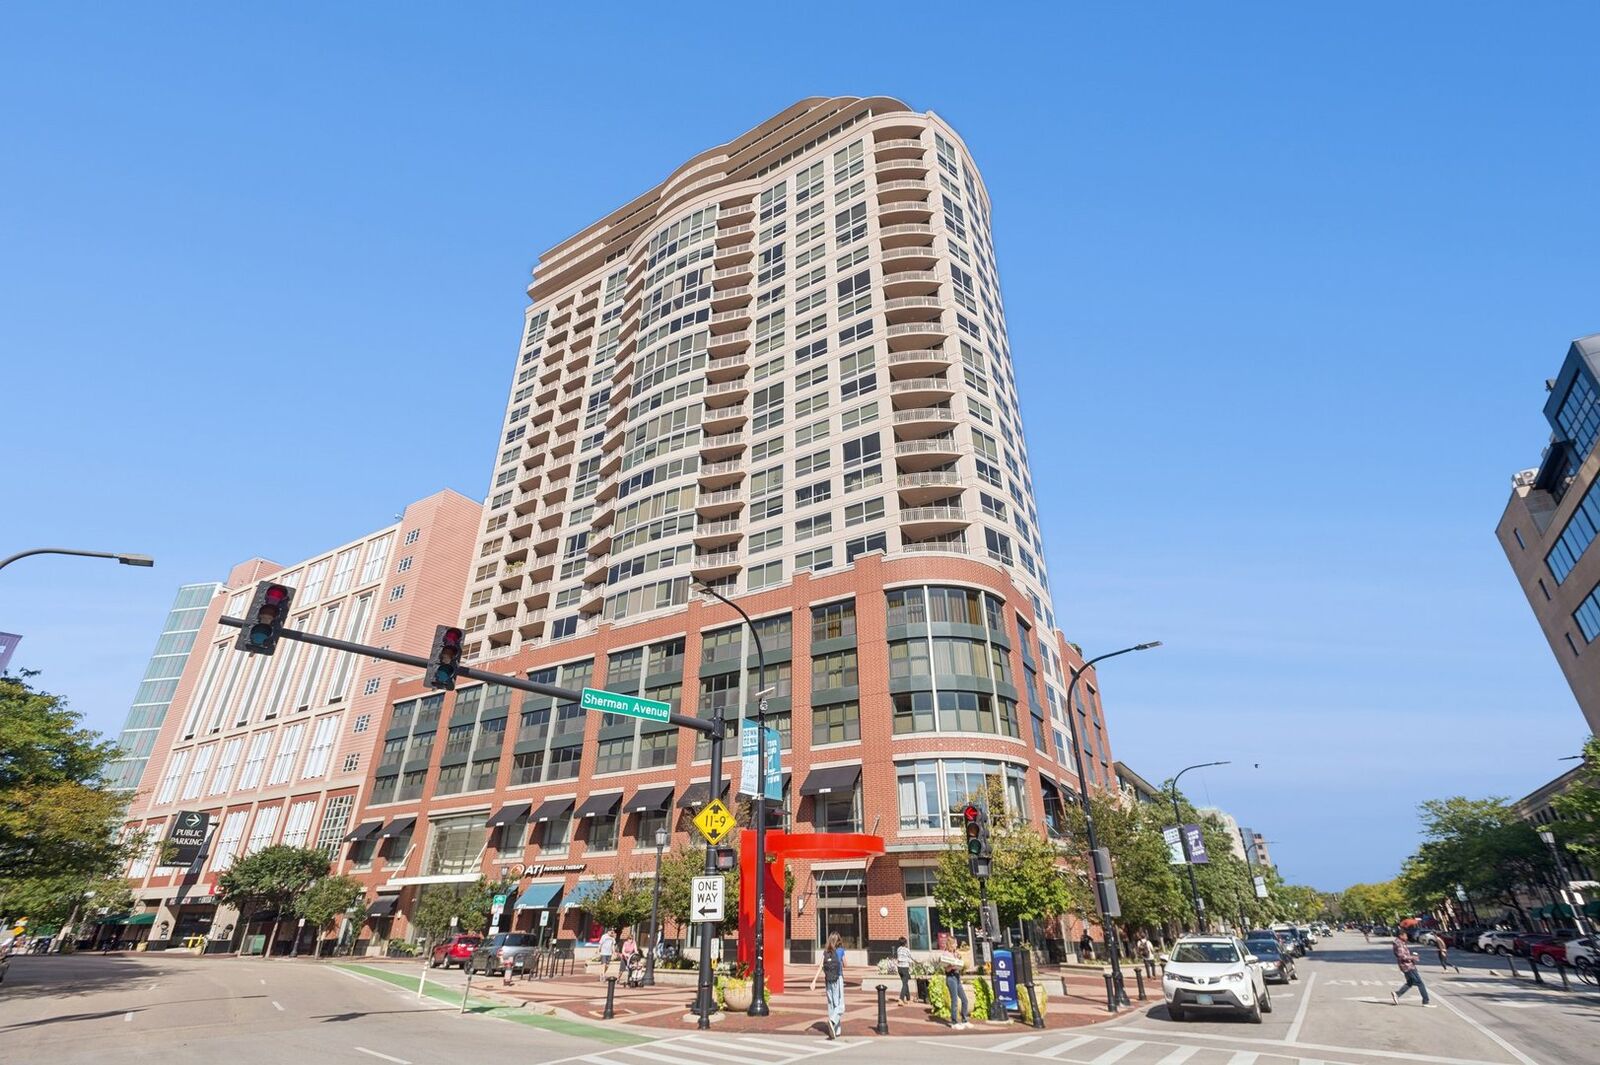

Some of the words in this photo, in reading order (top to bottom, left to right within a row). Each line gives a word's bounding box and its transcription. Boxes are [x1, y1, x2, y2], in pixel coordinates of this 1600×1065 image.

[584, 693, 628, 710] Sherman
[633, 703, 668, 718] Avenue
[705, 816, 727, 828] 11-9
[176, 828, 203, 837] PUBLIC
[171, 837, 204, 846] PARKING
[524, 864, 544, 875] ATI
[698, 881, 718, 891] ONE
[697, 893, 718, 904] WAY
